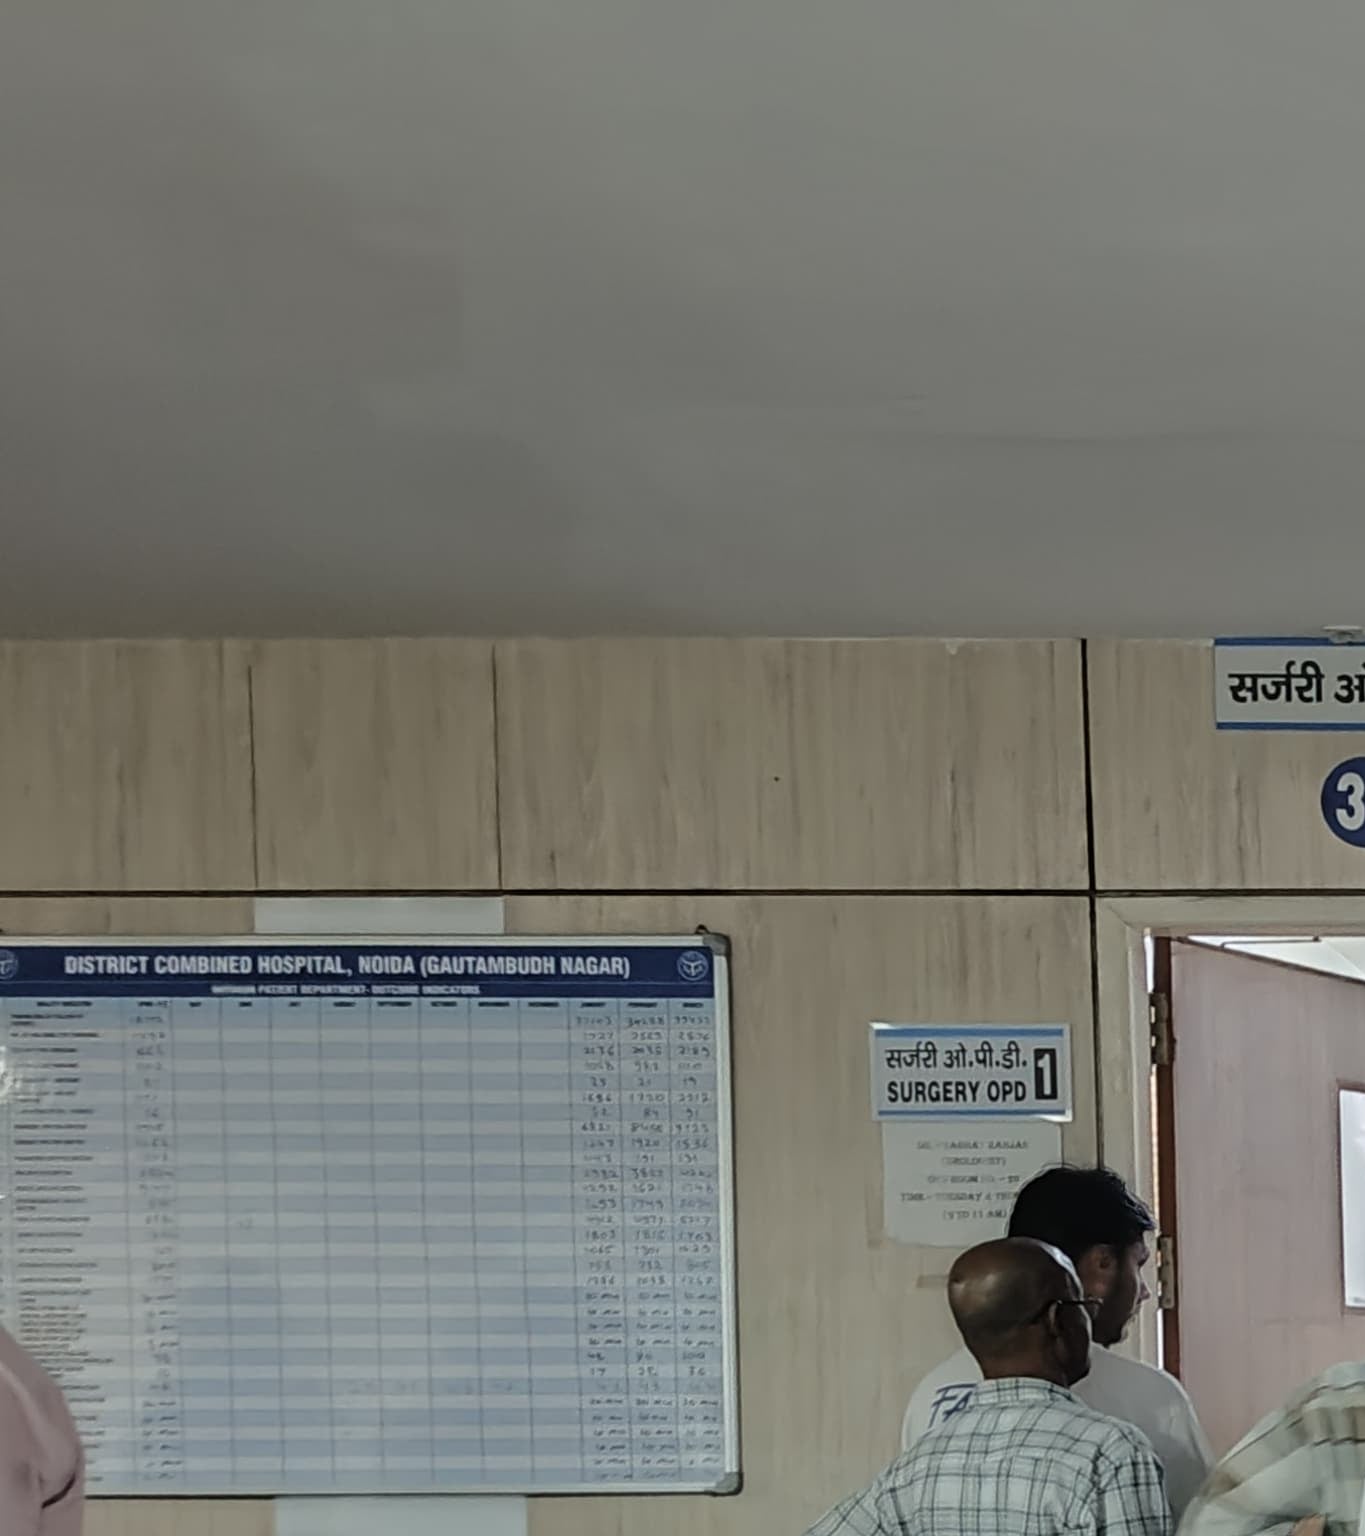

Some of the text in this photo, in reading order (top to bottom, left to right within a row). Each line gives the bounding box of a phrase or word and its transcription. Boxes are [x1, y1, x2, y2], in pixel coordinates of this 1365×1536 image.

[1228, 660, 1324, 703] सर्जरी
[65, 955, 630, 979] DISTRICT COMBINED HOSPITAL, NOIDA (GAUTAMBUDH NAGAR)
[885, 1040, 1027, 1069] सर्जरी ओ.पी.डी.
[1037, 1052, 1052, 1096] 1
[887, 1080, 1027, 1103] SURGERY OPD
